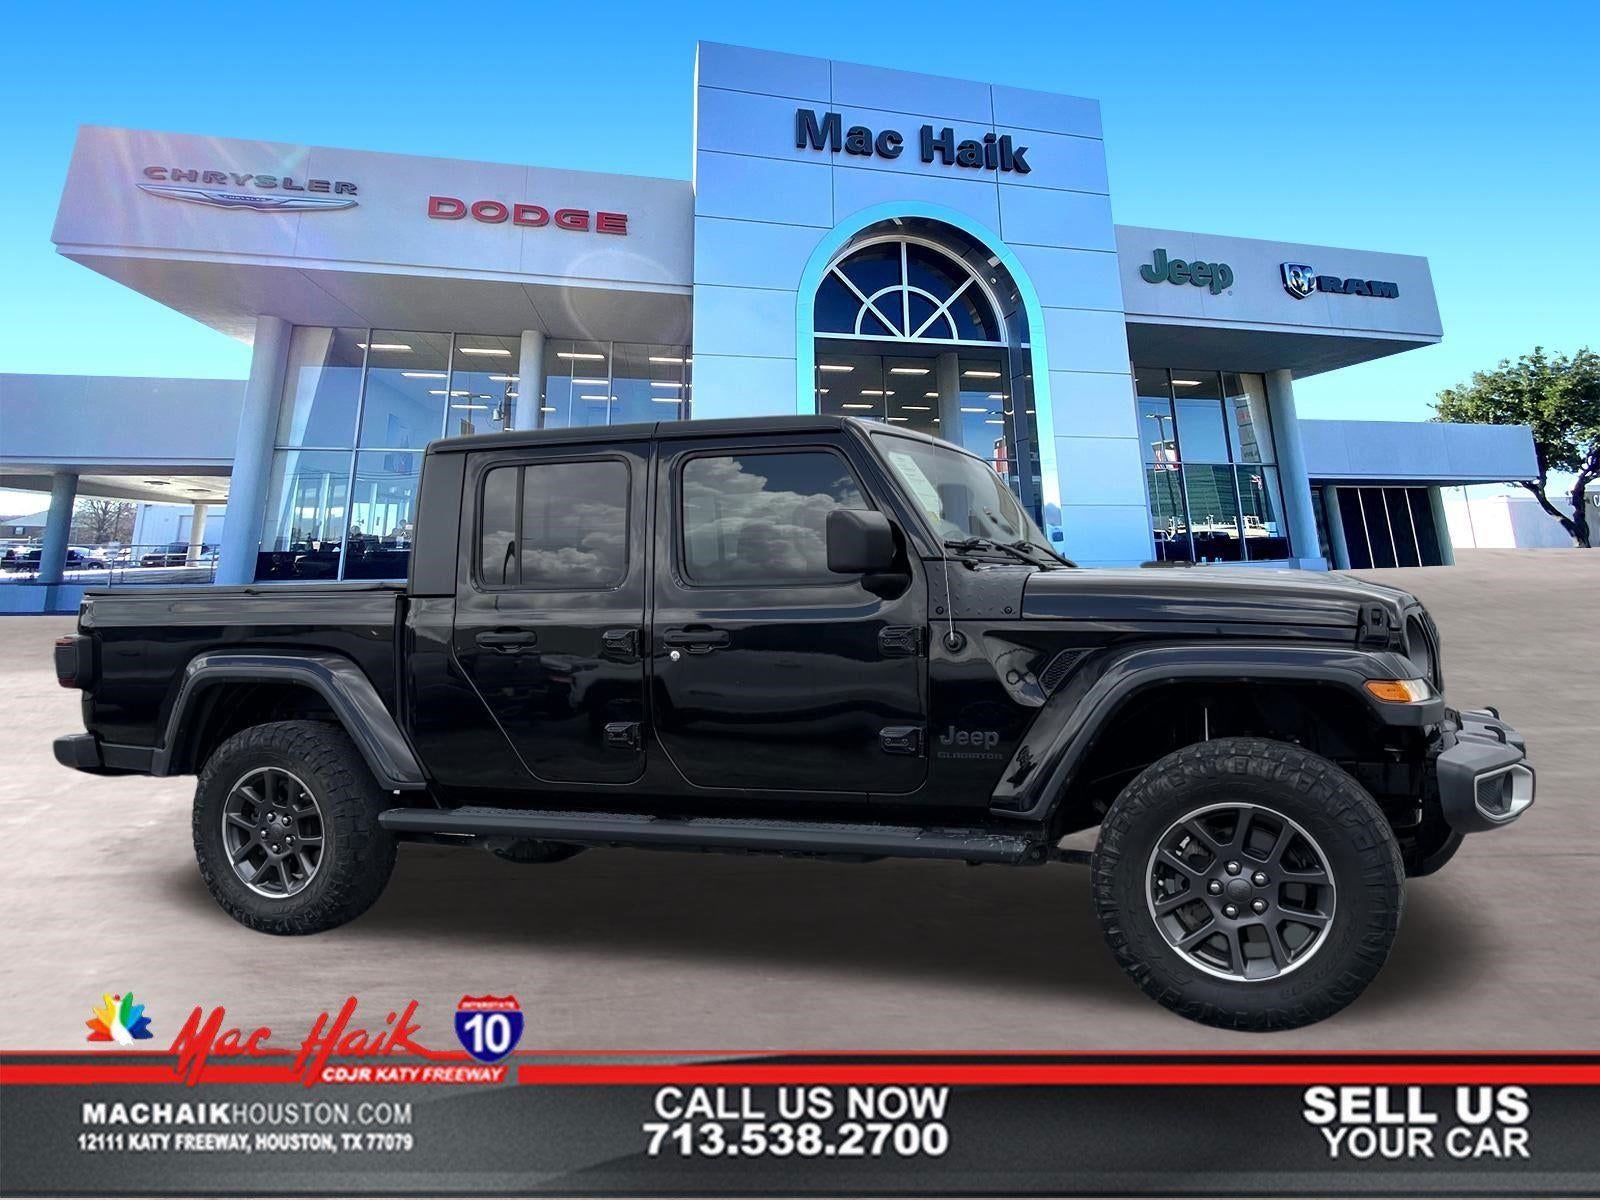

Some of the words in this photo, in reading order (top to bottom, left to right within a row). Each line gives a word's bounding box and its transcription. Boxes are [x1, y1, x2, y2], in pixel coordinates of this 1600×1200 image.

[796, 109, 904, 159] Mac
[920, 125, 1032, 174] Haik
[143, 166, 358, 196] CHRYSLER
[427, 195, 629, 236] DODGE
[1139, 248, 1234, 295] Jeep
[1315, 275, 1400, 299] RAM
[939, 725, 999, 750] Jeep
